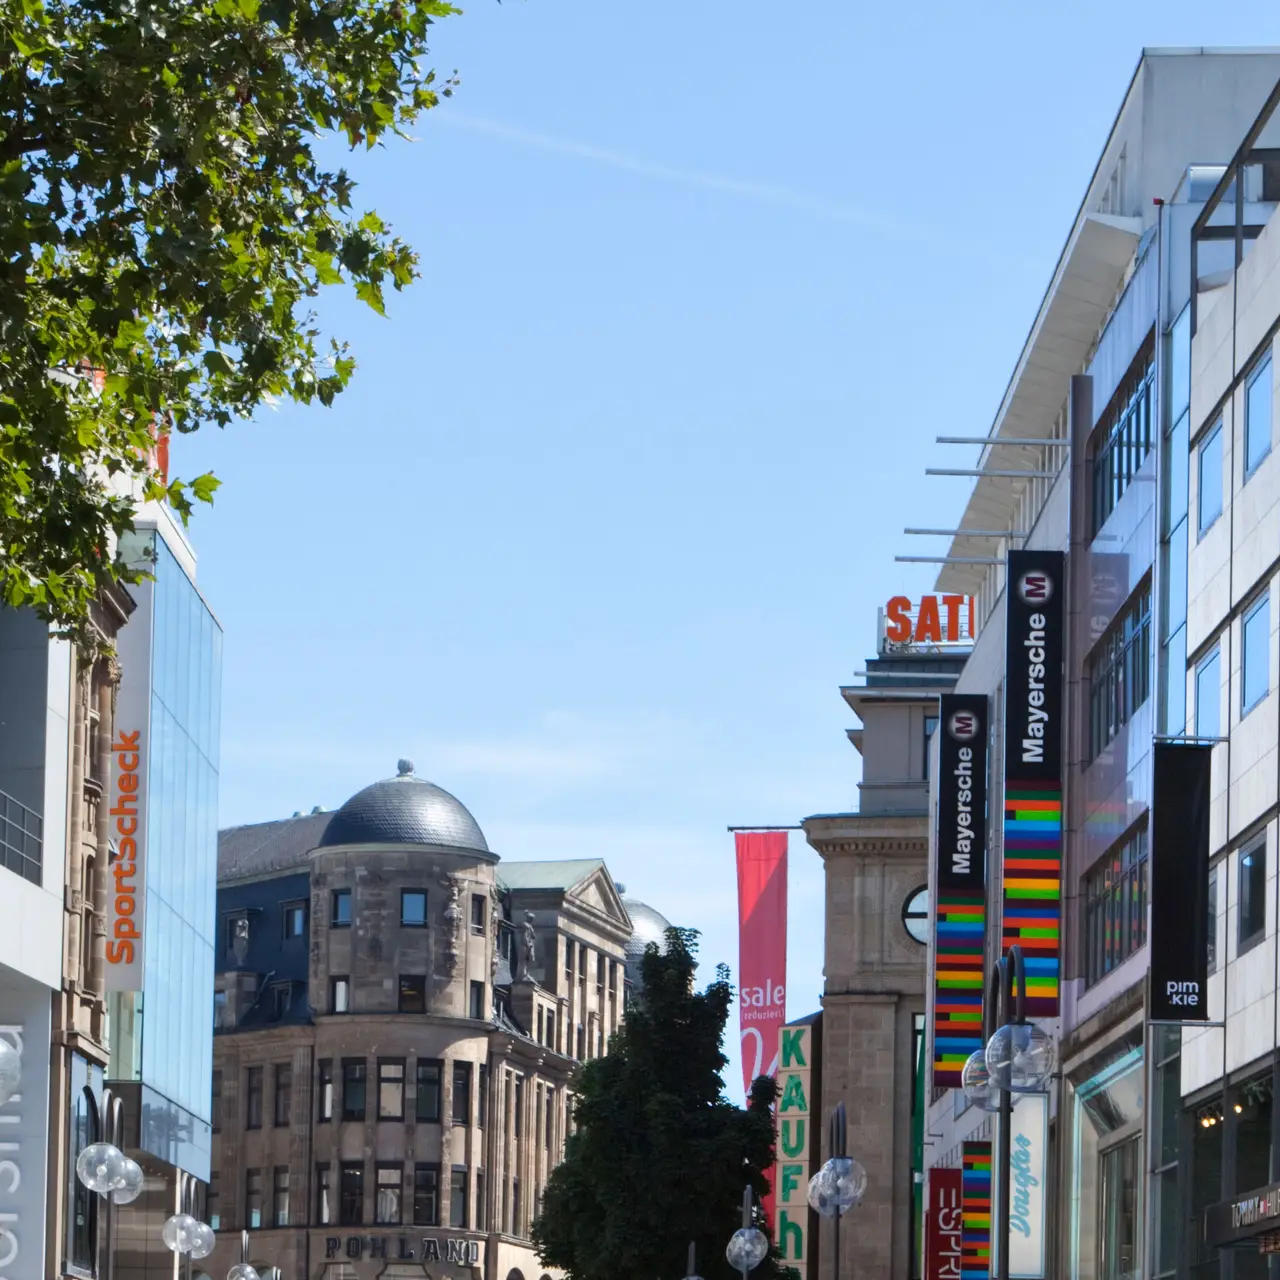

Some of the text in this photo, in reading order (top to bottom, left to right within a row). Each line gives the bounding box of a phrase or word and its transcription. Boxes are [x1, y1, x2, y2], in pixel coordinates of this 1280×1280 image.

[1021, 611, 1049, 763] Mayersche
[952, 747, 976, 874] Mayersche
[740, 978, 785, 1008] sale
[1166, 980, 1199, 996] pim
[1009, 1133, 1039, 1238] Douglas
[1231, 1195, 1260, 1229] TOMMY
[325, 1237, 480, 1263] POHLAND
